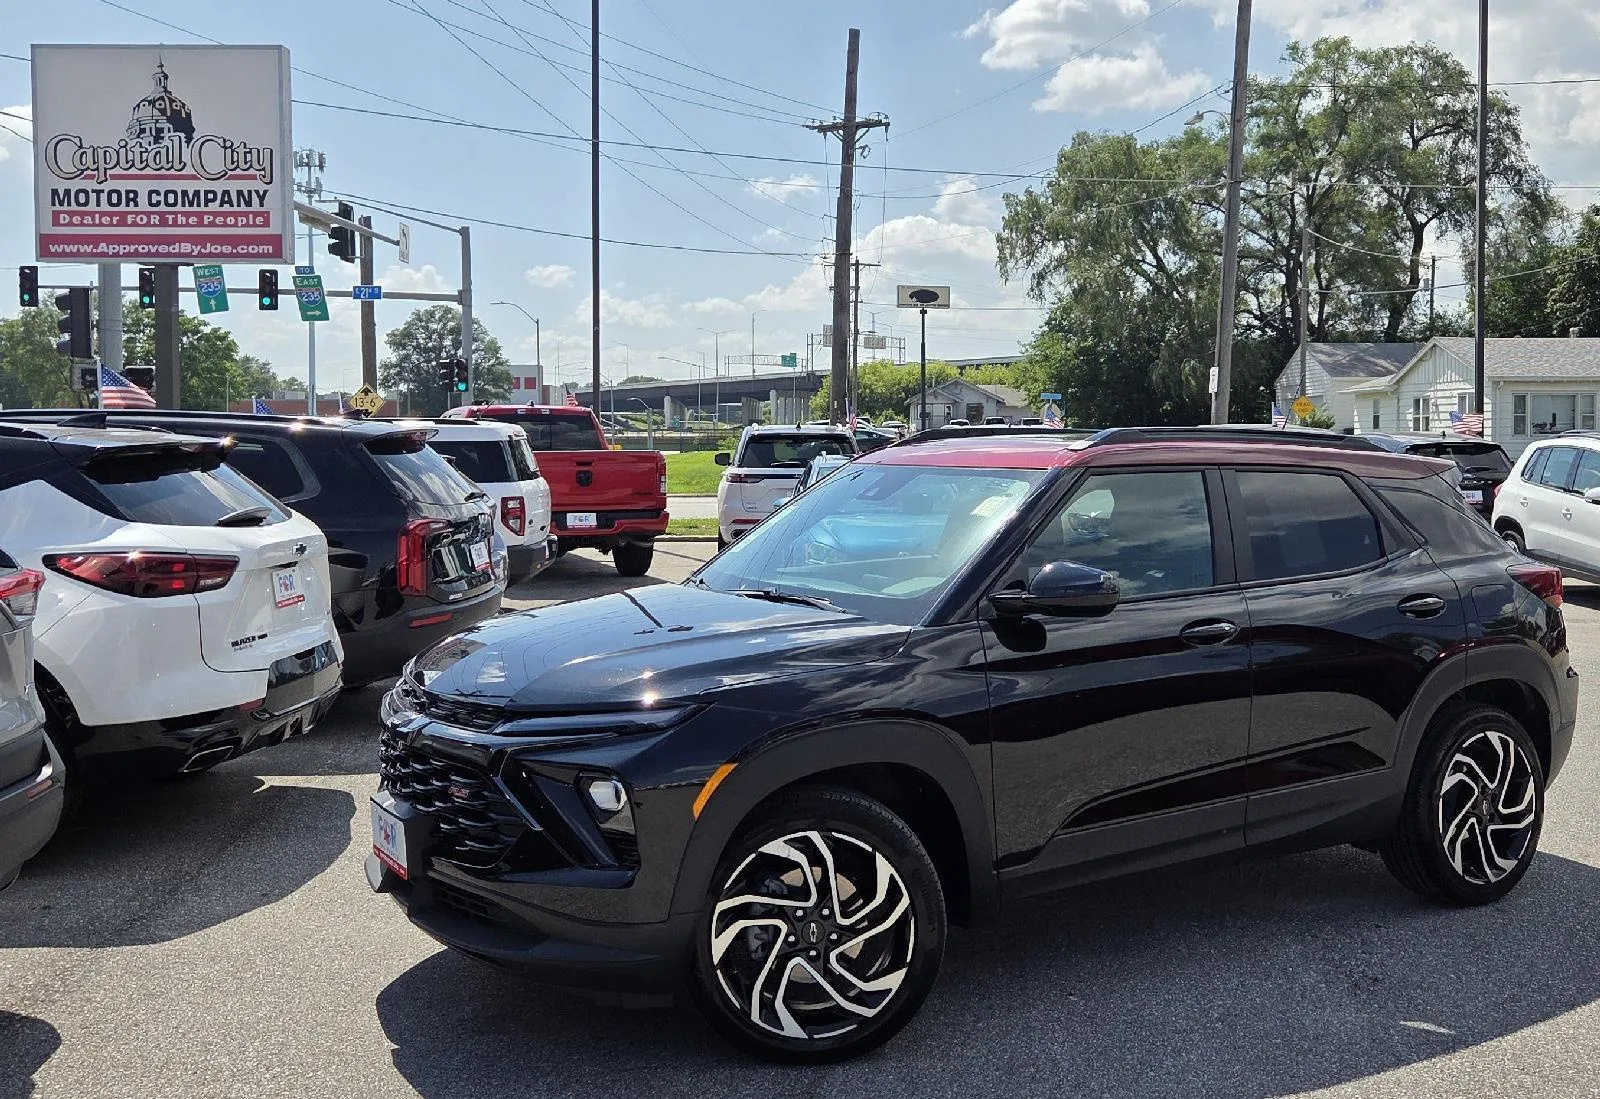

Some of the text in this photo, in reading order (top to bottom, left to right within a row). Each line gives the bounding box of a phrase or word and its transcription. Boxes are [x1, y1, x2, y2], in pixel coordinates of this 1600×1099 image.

[45, 134, 273, 185] Capital City
[50, 188, 269, 208] MOTOR COMPANY
[59, 213, 265, 227] Dealer FOR The People
[49, 241, 273, 256] www.ApprovedByJoe.com
[197, 267, 220, 276] WEST
[200, 281, 221, 293] 235
[296, 277, 319, 286] EAST
[301, 291, 321, 302] 235
[231, 635, 257, 648] BLAZER
